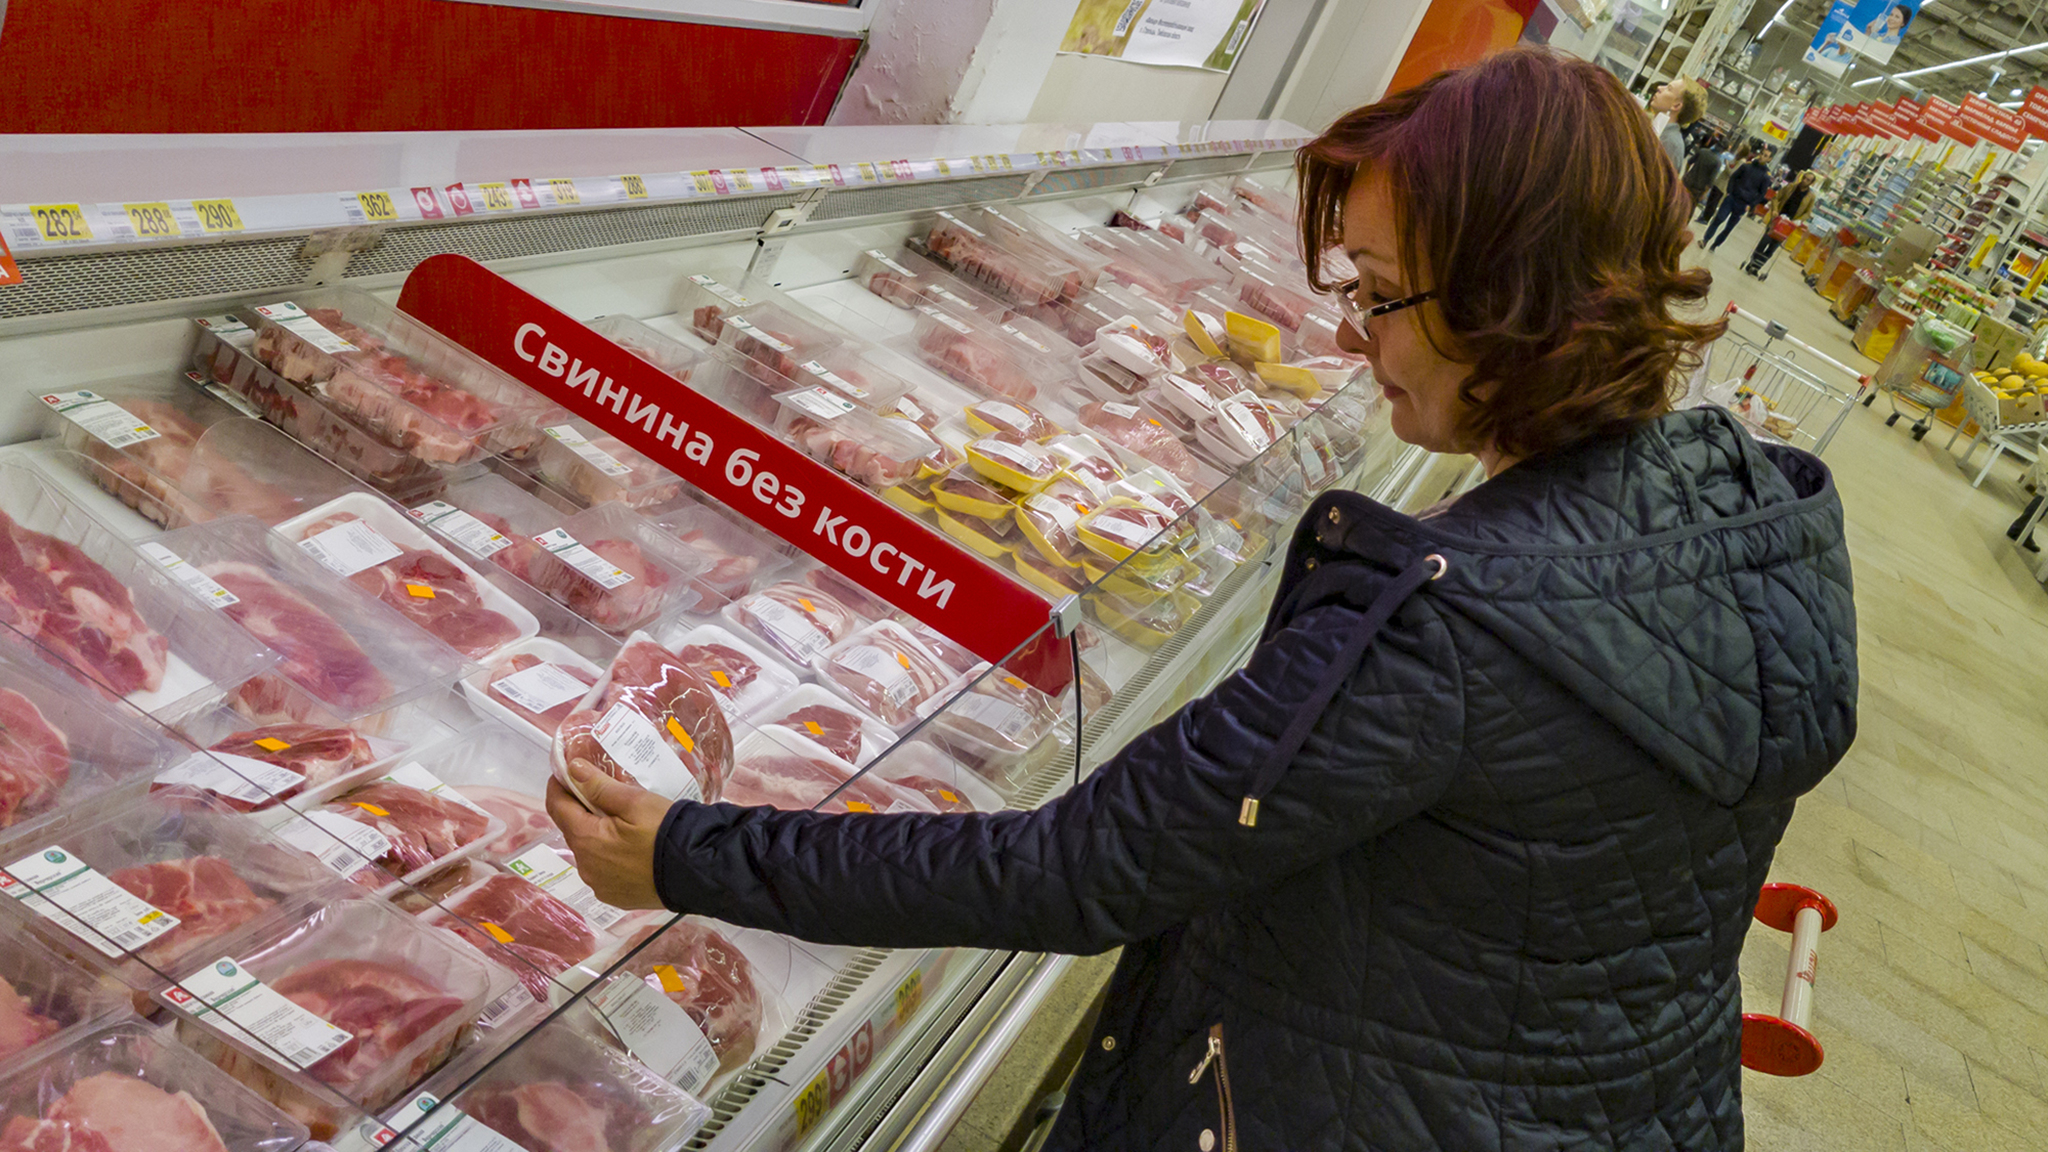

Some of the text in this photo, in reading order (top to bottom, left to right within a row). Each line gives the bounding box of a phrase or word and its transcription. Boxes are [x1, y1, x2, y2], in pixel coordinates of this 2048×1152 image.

[199, 203, 233, 229] 290
[361, 194, 390, 217] 362
[37, 209, 81, 237] 282
[131, 207, 170, 234] 288
[514, 322, 714, 466] Свинина
[725, 448, 806, 518] без
[812, 506, 956, 610] кости
